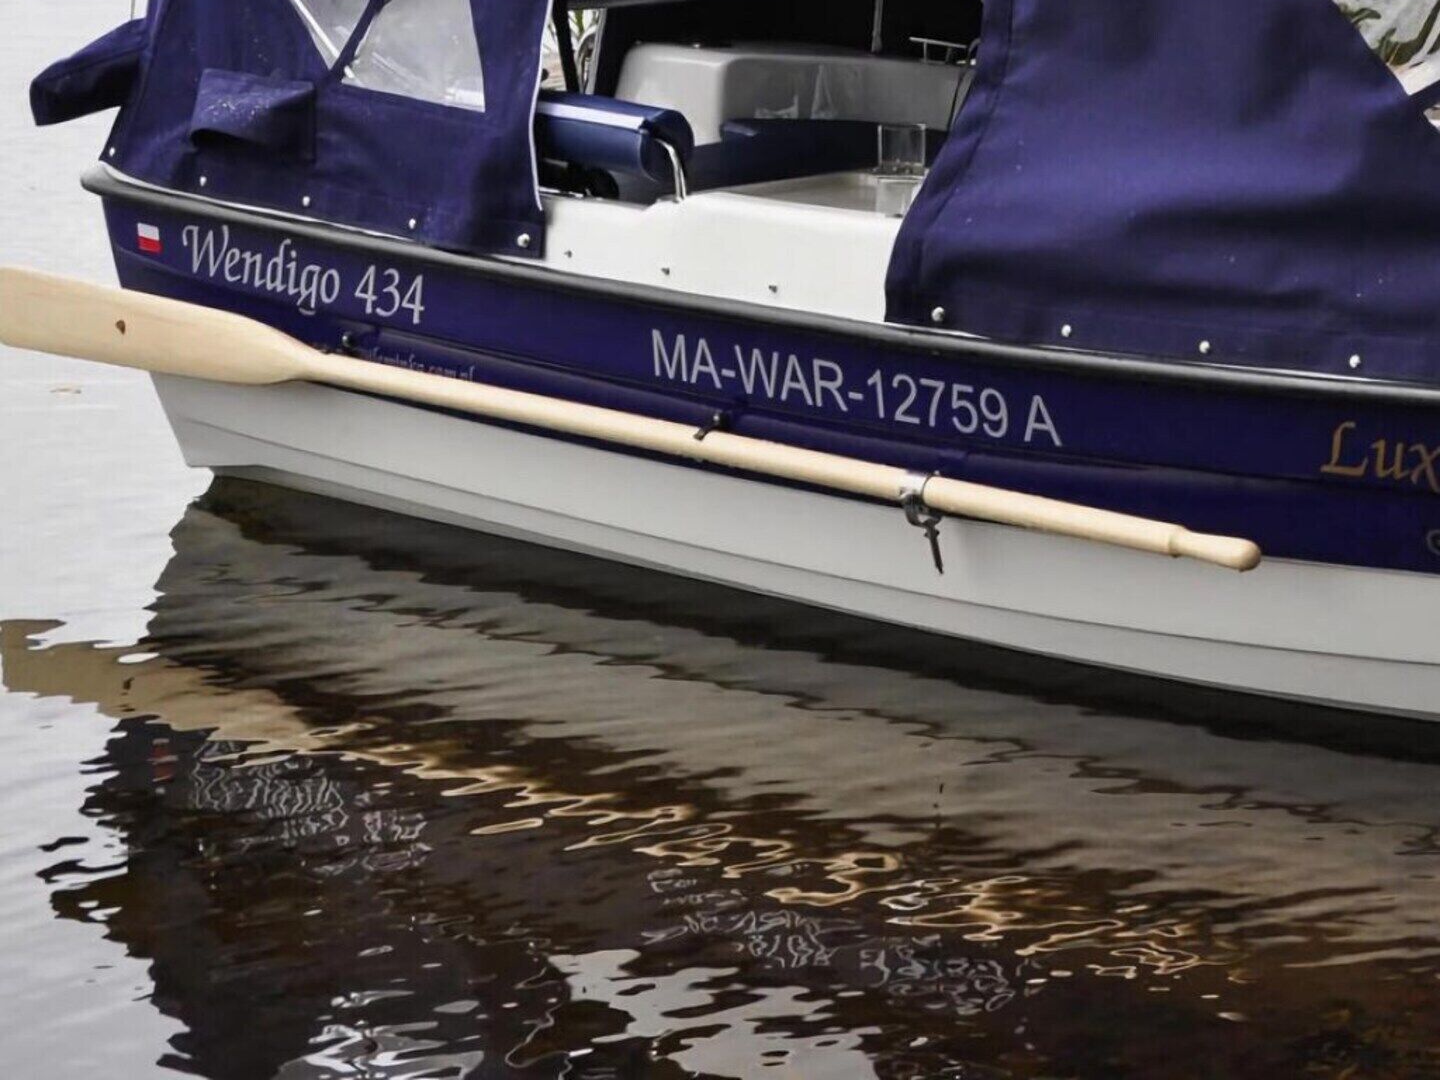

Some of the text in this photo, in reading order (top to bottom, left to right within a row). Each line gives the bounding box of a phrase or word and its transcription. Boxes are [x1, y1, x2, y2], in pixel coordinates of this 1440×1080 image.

[183, 224, 424, 324] Wendigo 434
[652, 329, 1062, 446] MA-WAR-12759 A
